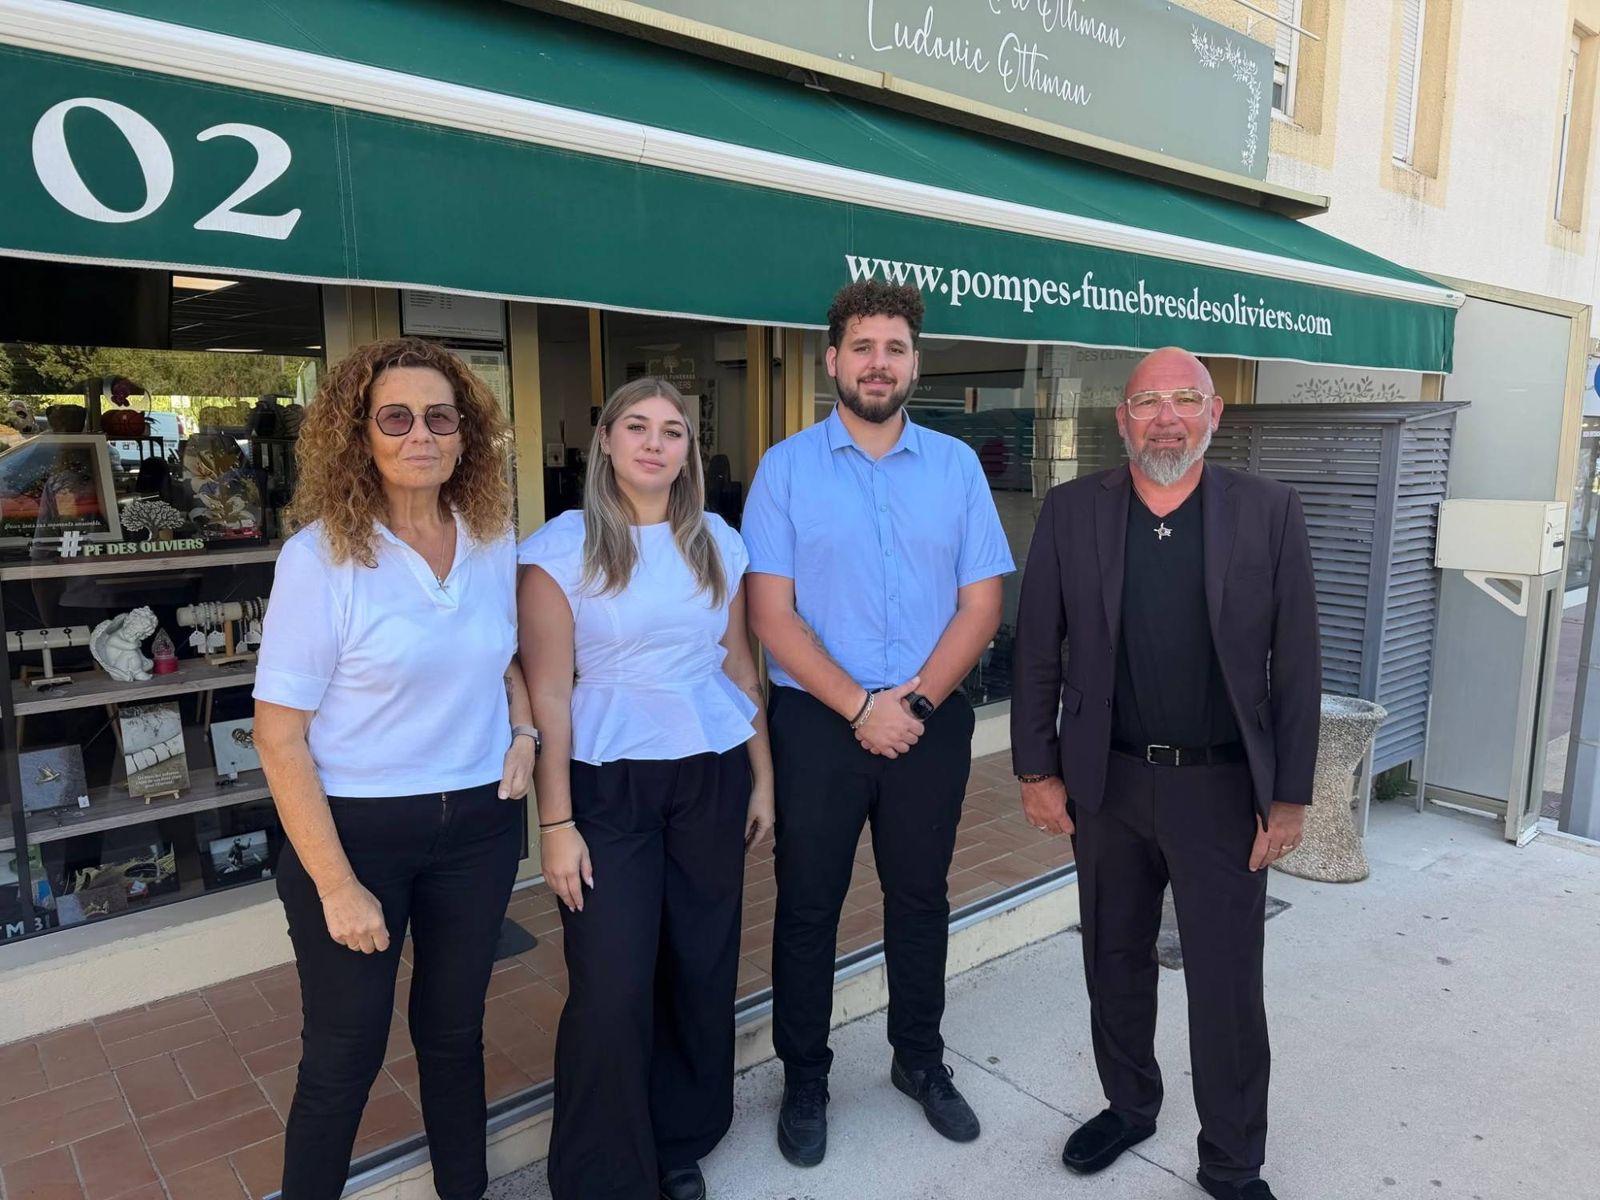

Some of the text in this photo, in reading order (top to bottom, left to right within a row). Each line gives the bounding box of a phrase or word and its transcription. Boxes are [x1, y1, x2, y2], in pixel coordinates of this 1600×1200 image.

[866, 0, 1092, 106] Ludovic Othman
[845, 254, 1334, 336] www.pompes-funebresdesoliviers.com
[107, 541, 138, 555] DES
[140, 538, 205, 553] OLIVIERS
